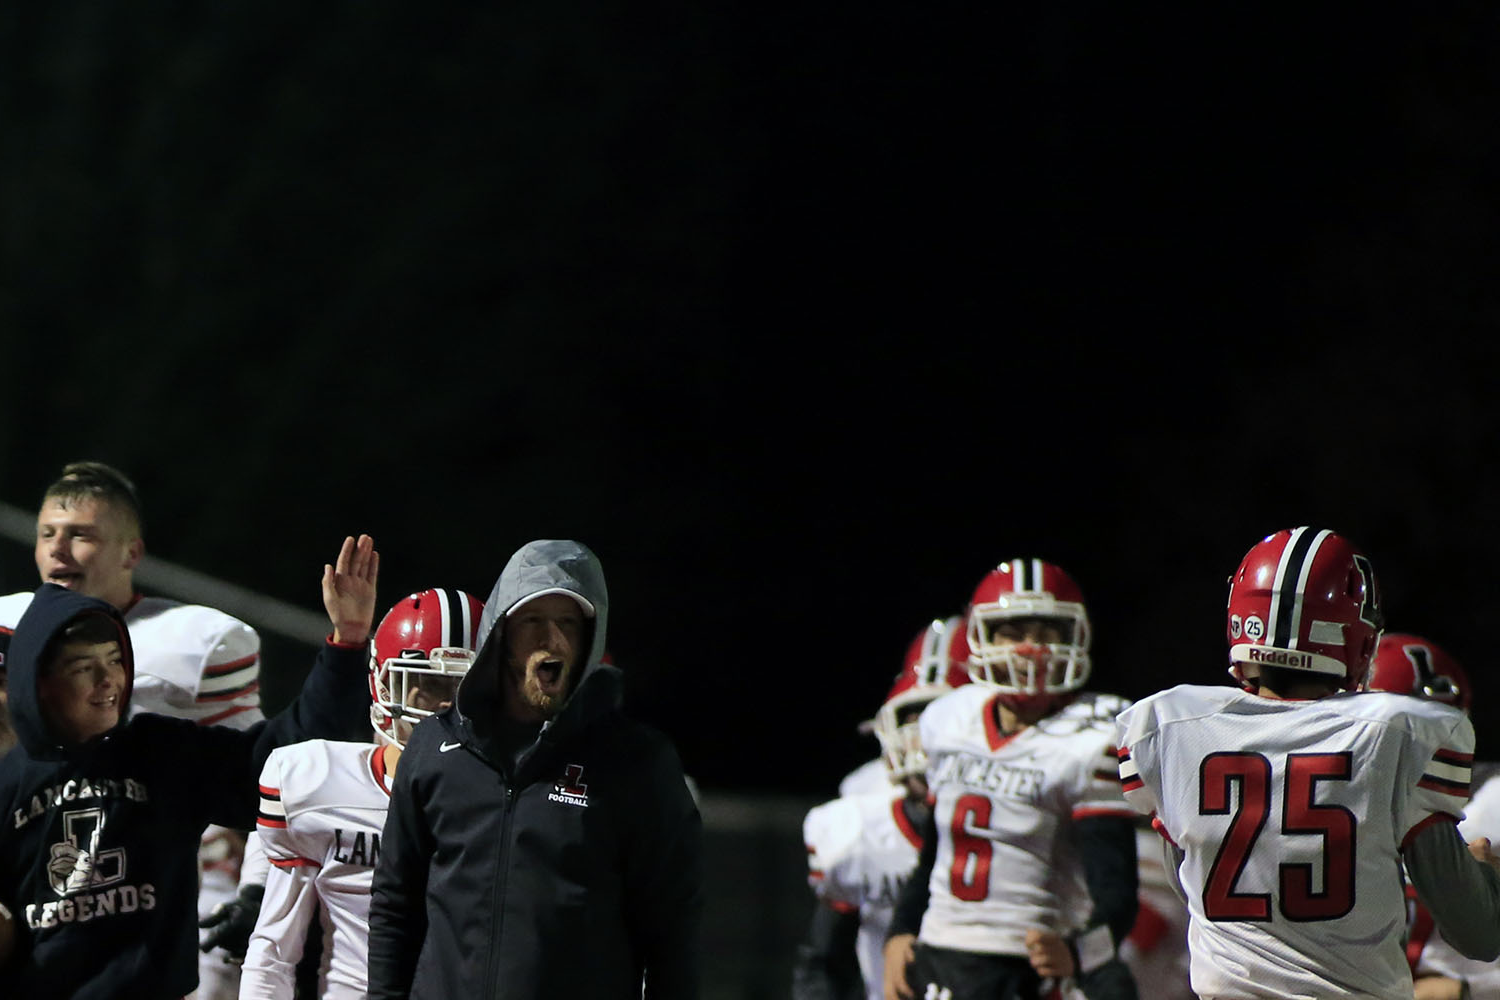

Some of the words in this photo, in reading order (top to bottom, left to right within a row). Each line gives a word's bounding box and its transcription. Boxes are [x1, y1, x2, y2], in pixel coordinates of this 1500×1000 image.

[1247, 620, 1261, 636] 25
[1249, 648, 1313, 669] Riddell
[548, 793, 589, 807] FOOTBALL
[951, 794, 993, 902] 6
[1199, 751, 1357, 923] 25
[25, 883, 156, 929] LEGENDS
